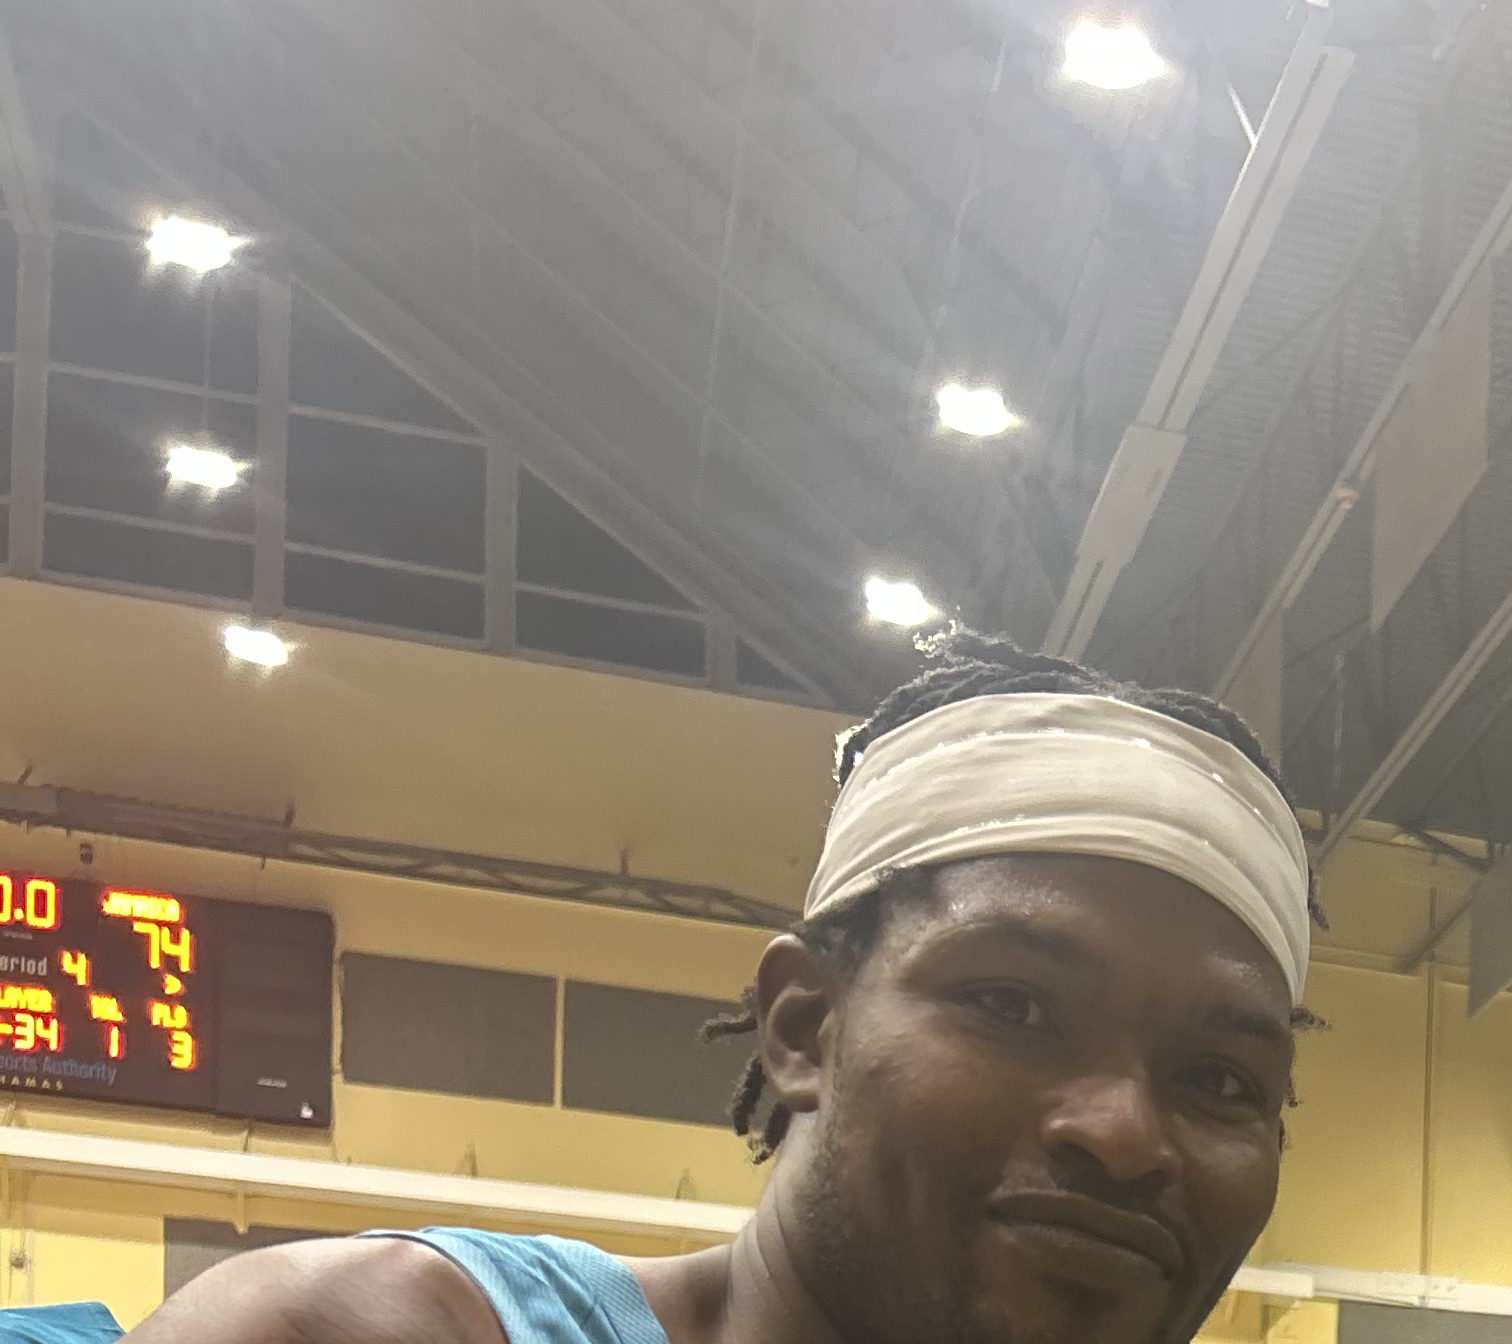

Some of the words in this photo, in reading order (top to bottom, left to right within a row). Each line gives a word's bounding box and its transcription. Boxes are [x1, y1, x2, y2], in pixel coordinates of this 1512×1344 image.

[133, 921, 191, 973] 74
[61, 950, 88, 987] 4
[109, 1025, 120, 1058] 1
[171, 1030, 193, 1069] 3
[43, 1055, 118, 1086] Authority
